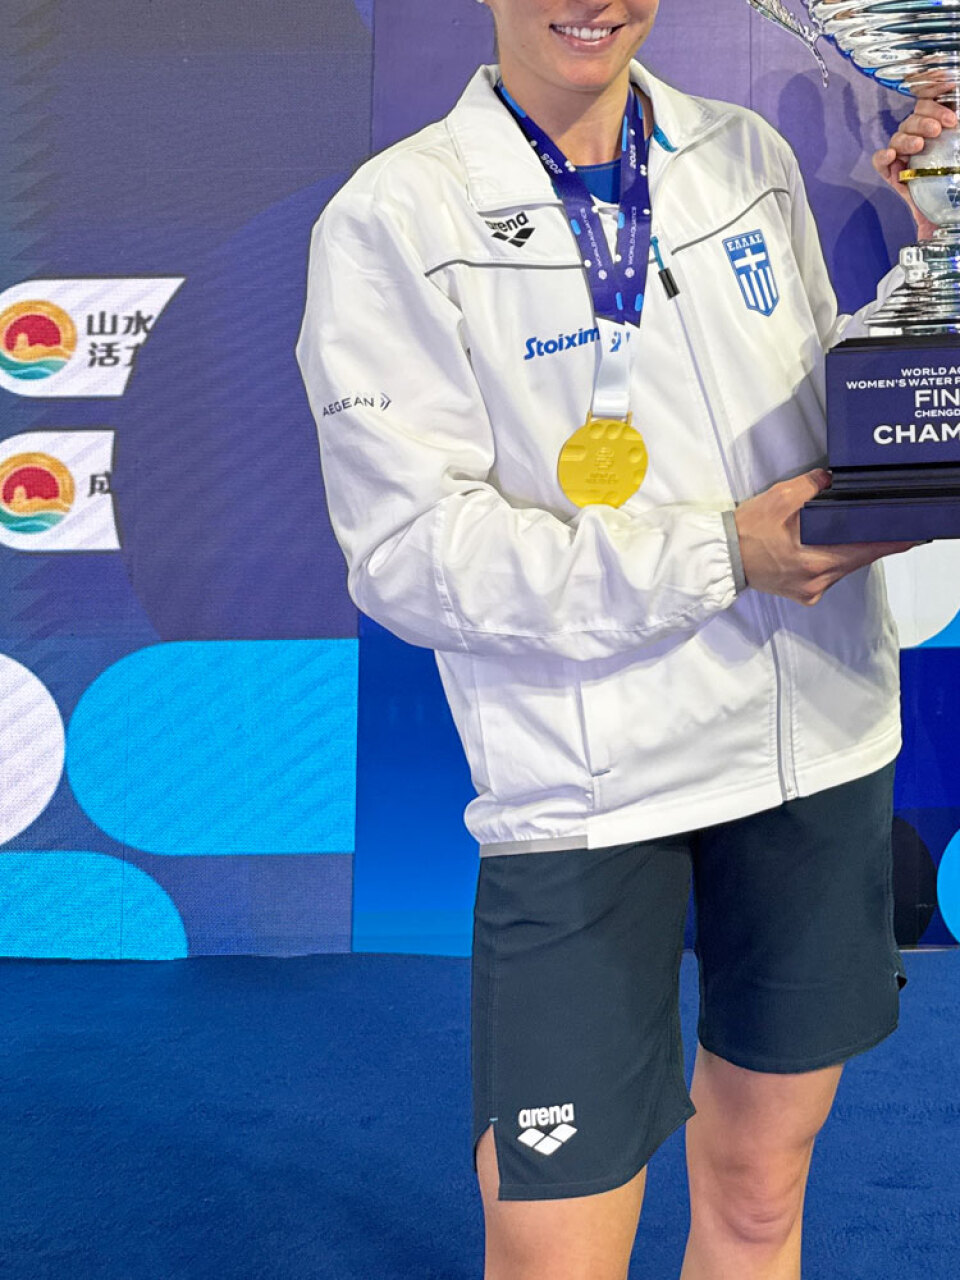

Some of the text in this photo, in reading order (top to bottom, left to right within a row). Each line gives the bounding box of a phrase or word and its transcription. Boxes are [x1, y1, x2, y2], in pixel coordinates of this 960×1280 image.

[540, 153, 562, 174] 2025
[901, 367, 947, 377] WORLD
[846, 378, 907, 389] WOMEN'S
[909, 377, 952, 387] WATER
[323, 396, 374, 416] AEGEAN
[518, 1103, 575, 1128] arena
